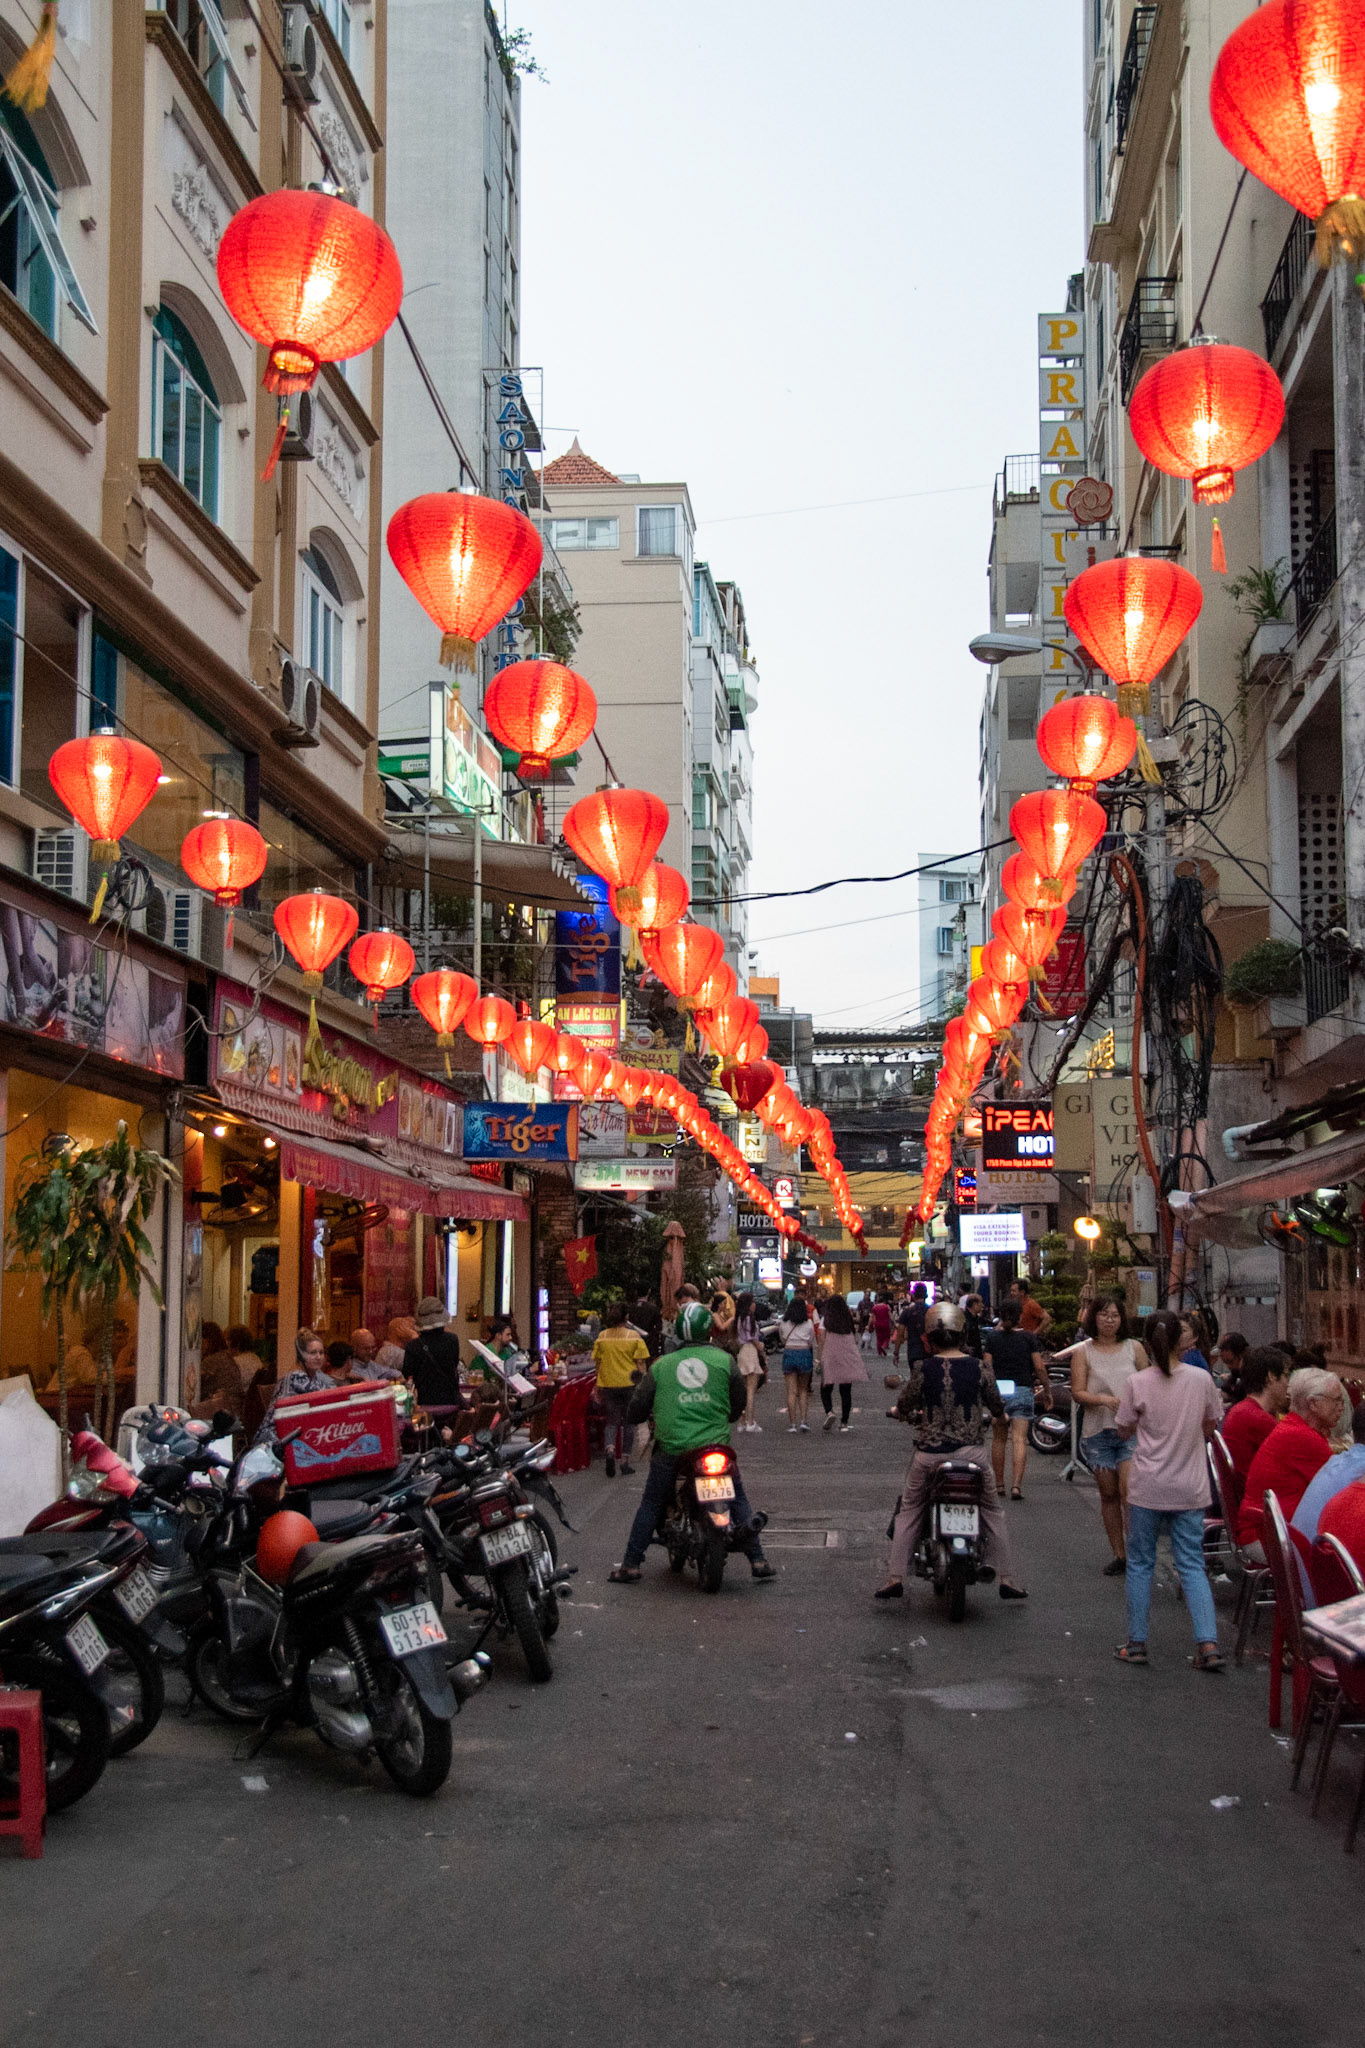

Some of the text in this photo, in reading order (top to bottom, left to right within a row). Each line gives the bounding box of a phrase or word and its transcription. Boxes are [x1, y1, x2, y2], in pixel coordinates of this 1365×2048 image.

[497, 374, 527, 452] SAO
[557, 1007, 571, 1021] AN
[572, 1007, 591, 1021] LAC
[592, 1007, 618, 1021] CHAY
[985, 1106, 1054, 1131] iPEA
[485, 1114, 561, 1153] Tiger
[625, 1169, 649, 1181] NEW
[652, 1169, 674, 1181] SKY
[987, 1172, 1047, 1184] HOTEL
[739, 1214, 776, 1228] HOTEL
[304, 1422, 365, 1447] Hitaco
[391, 1607, 432, 1632] 60-F2
[393, 1624, 445, 1653] 513.14
